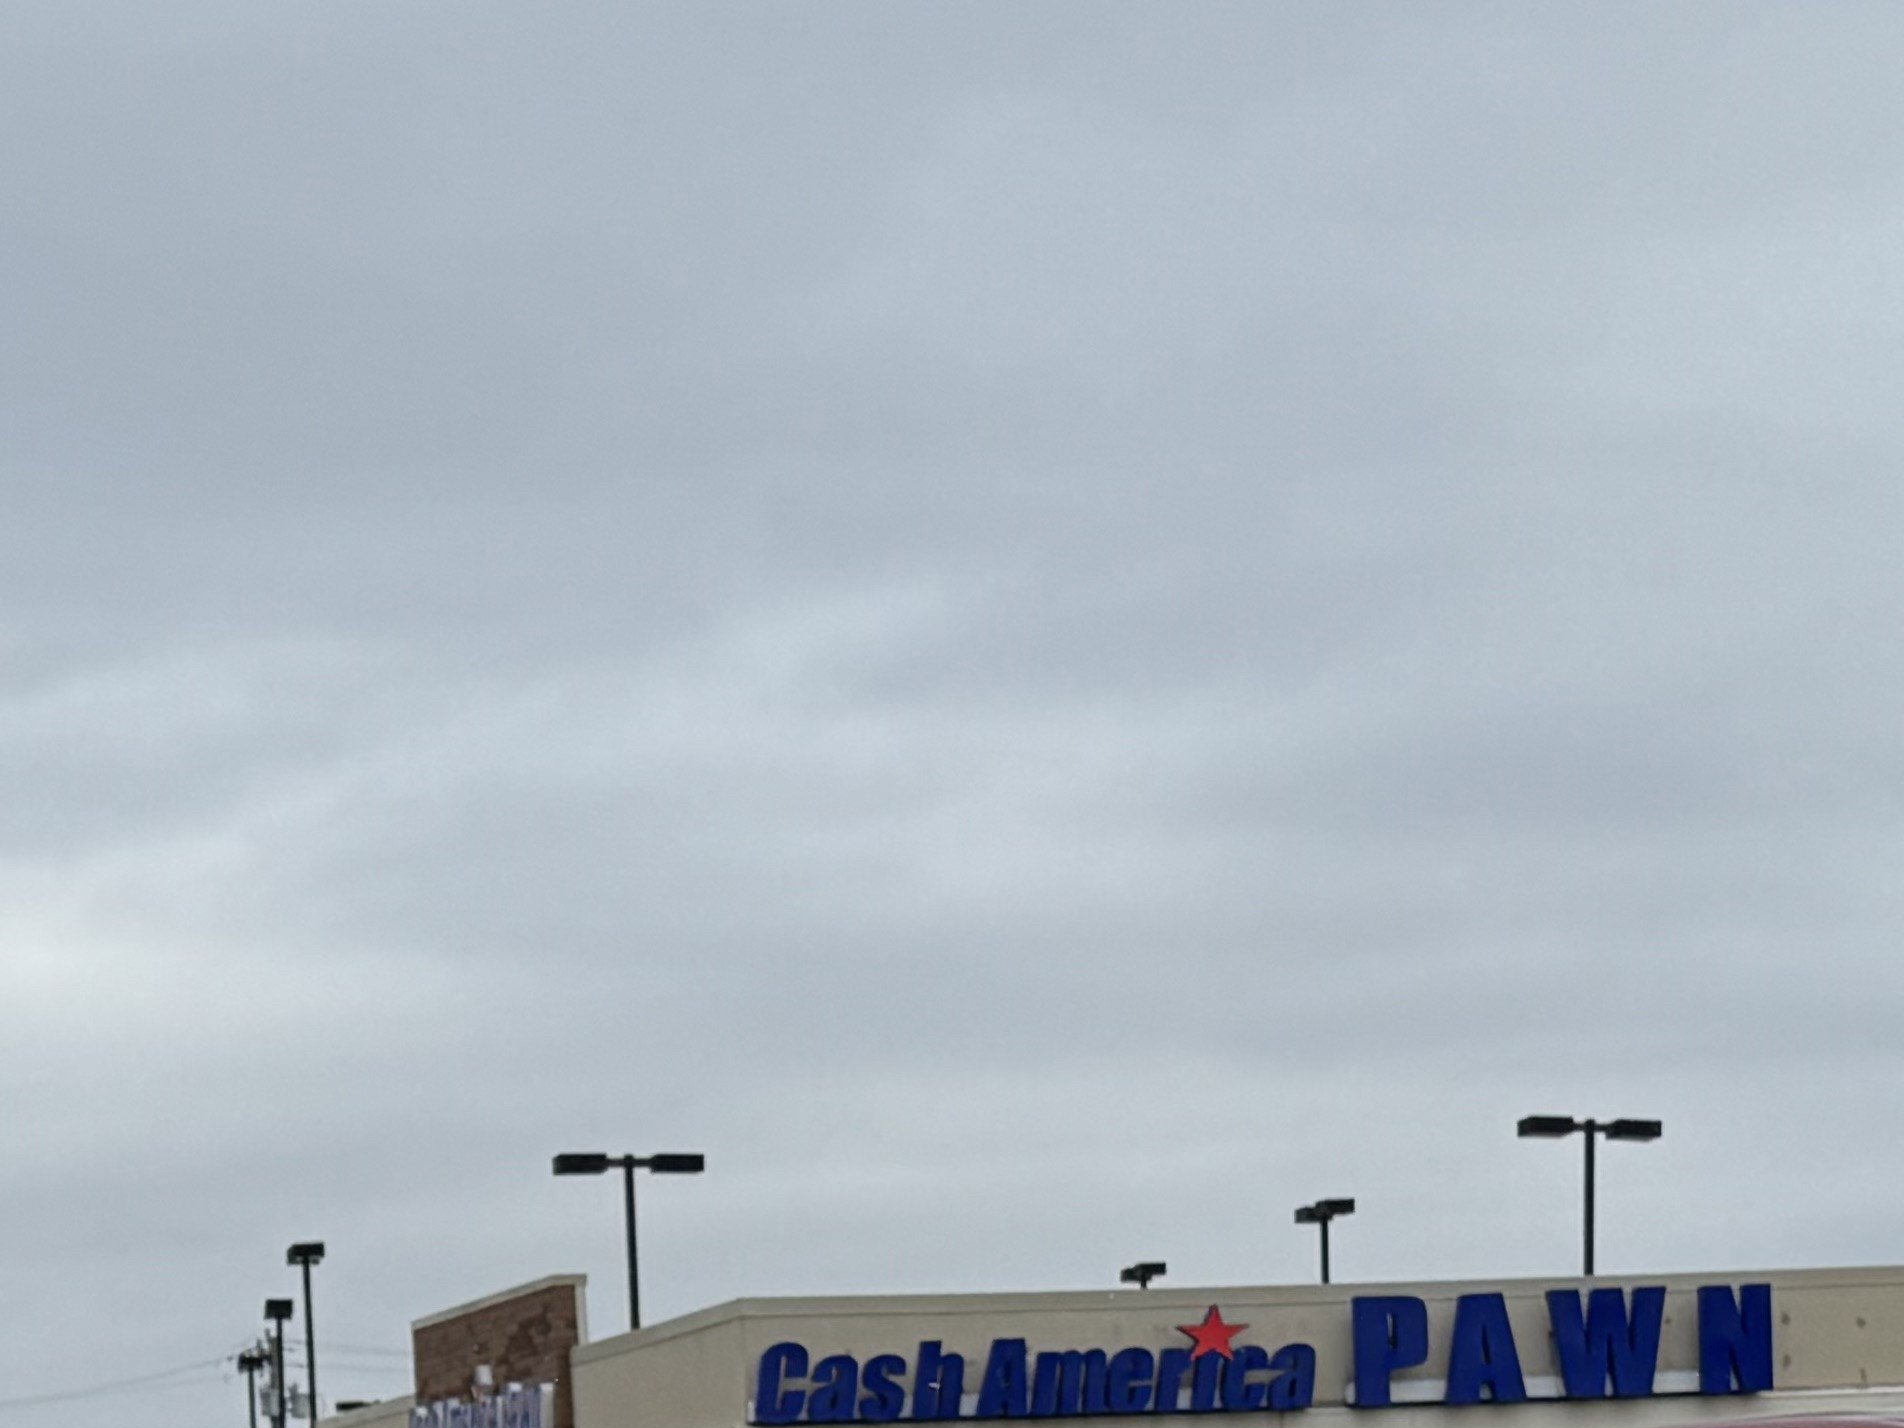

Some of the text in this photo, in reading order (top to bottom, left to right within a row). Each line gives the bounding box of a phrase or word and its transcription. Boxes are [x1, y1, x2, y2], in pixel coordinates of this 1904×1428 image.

[754, 1283, 1773, 1425] Cash America PAWN
